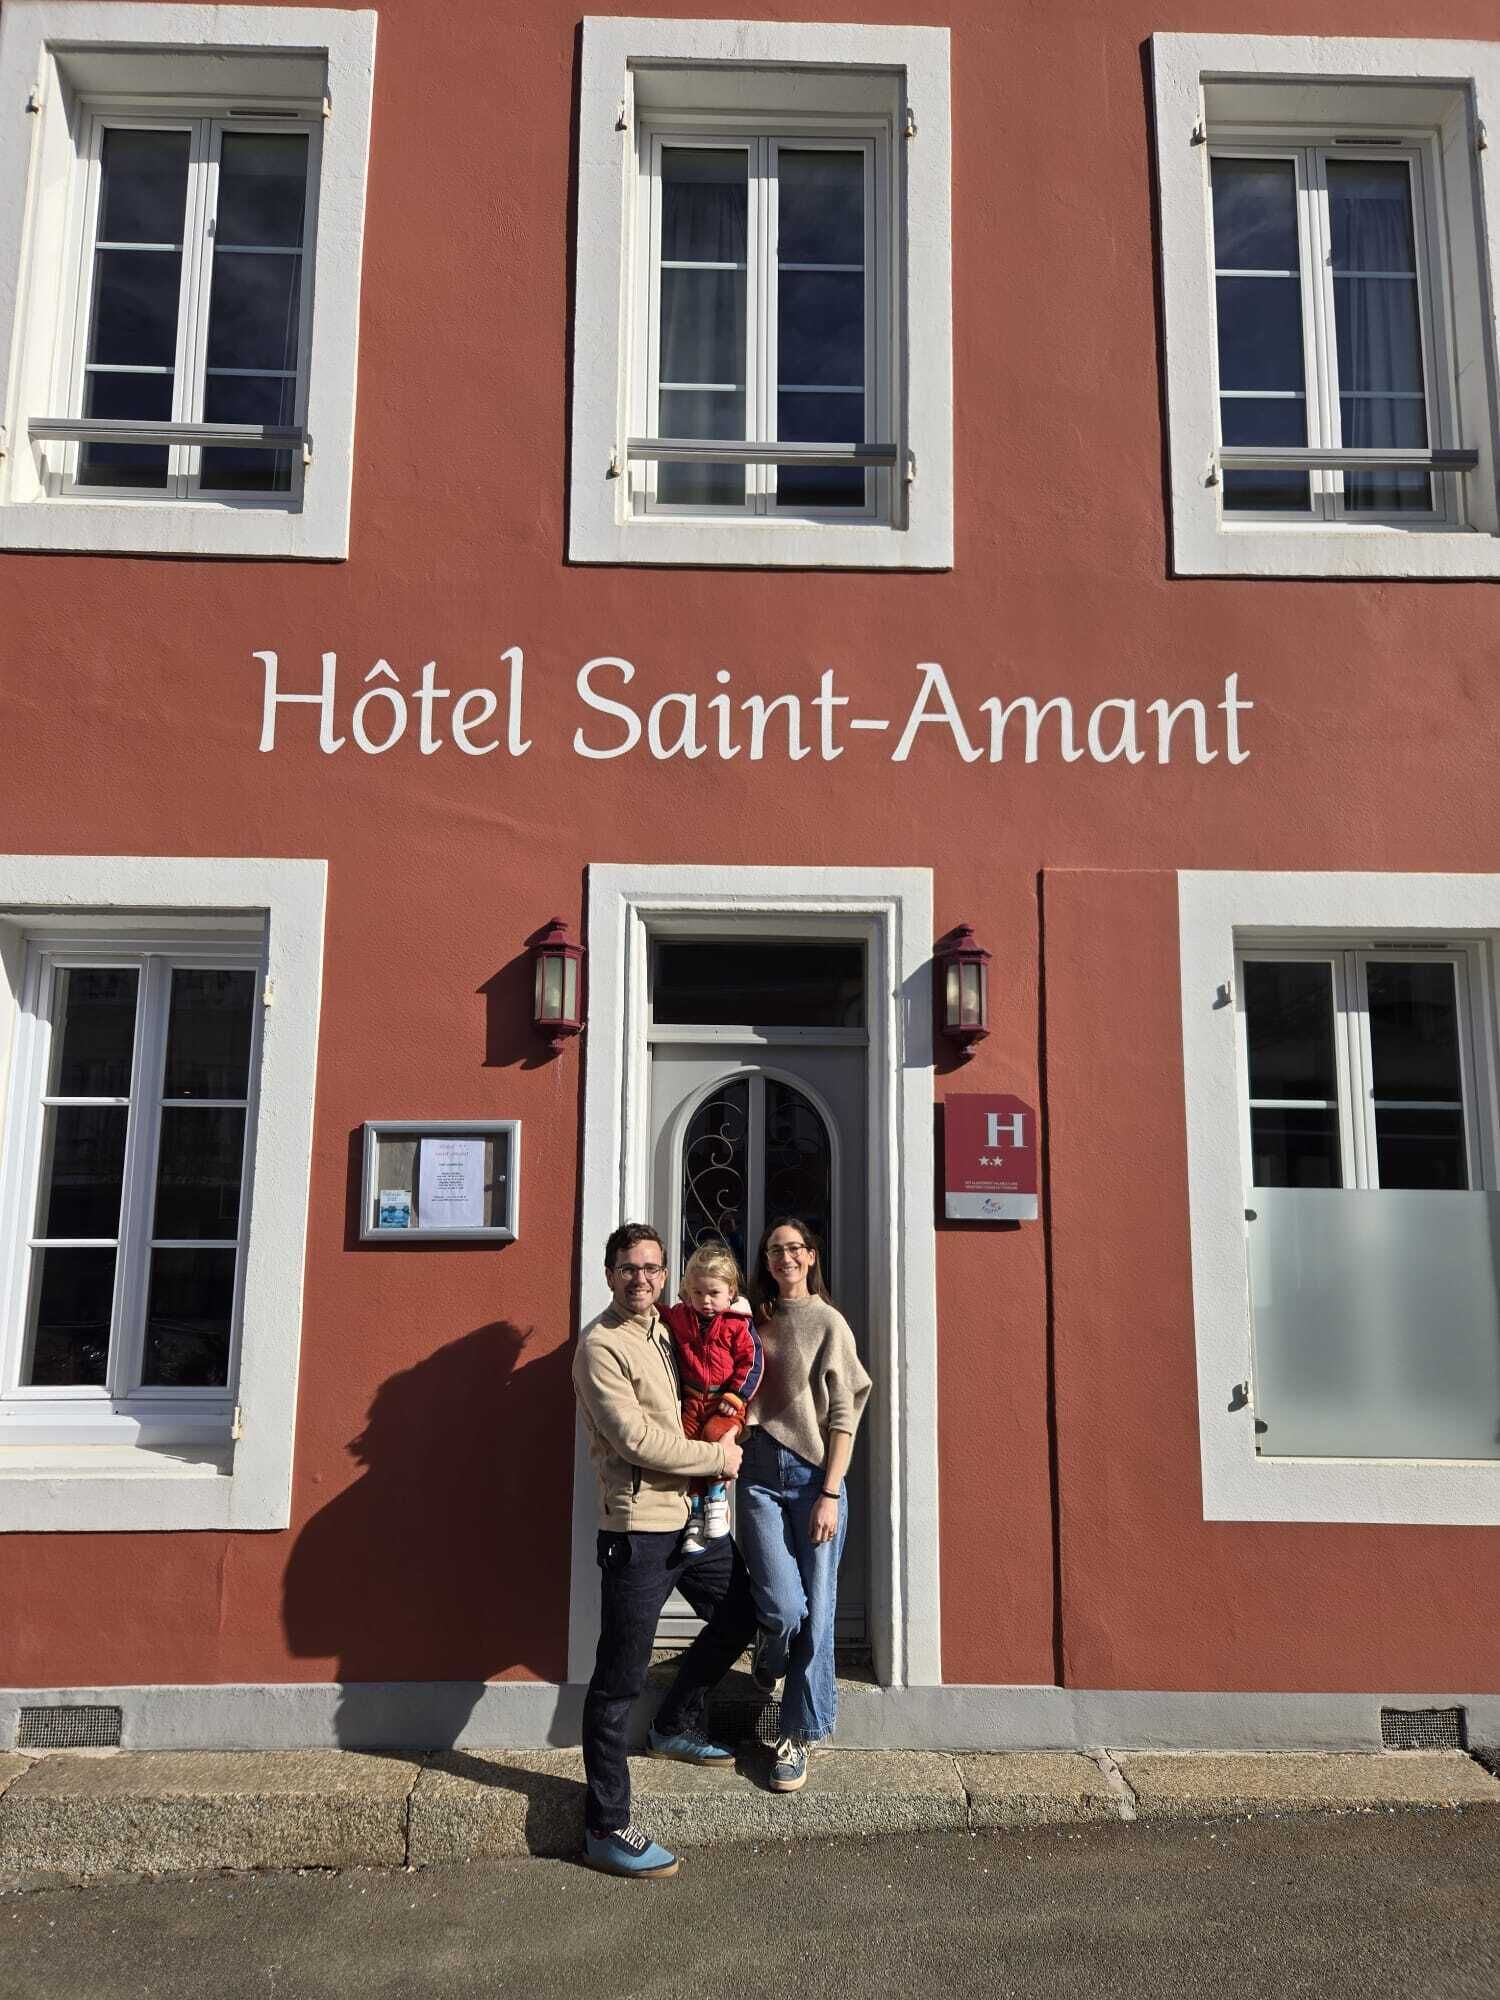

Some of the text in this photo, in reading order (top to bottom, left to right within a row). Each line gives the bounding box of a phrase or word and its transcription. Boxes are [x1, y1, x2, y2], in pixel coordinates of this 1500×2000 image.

[252, 645, 1255, 765] Hôtel Saint-Amant
[984, 1112, 1029, 1148] H
